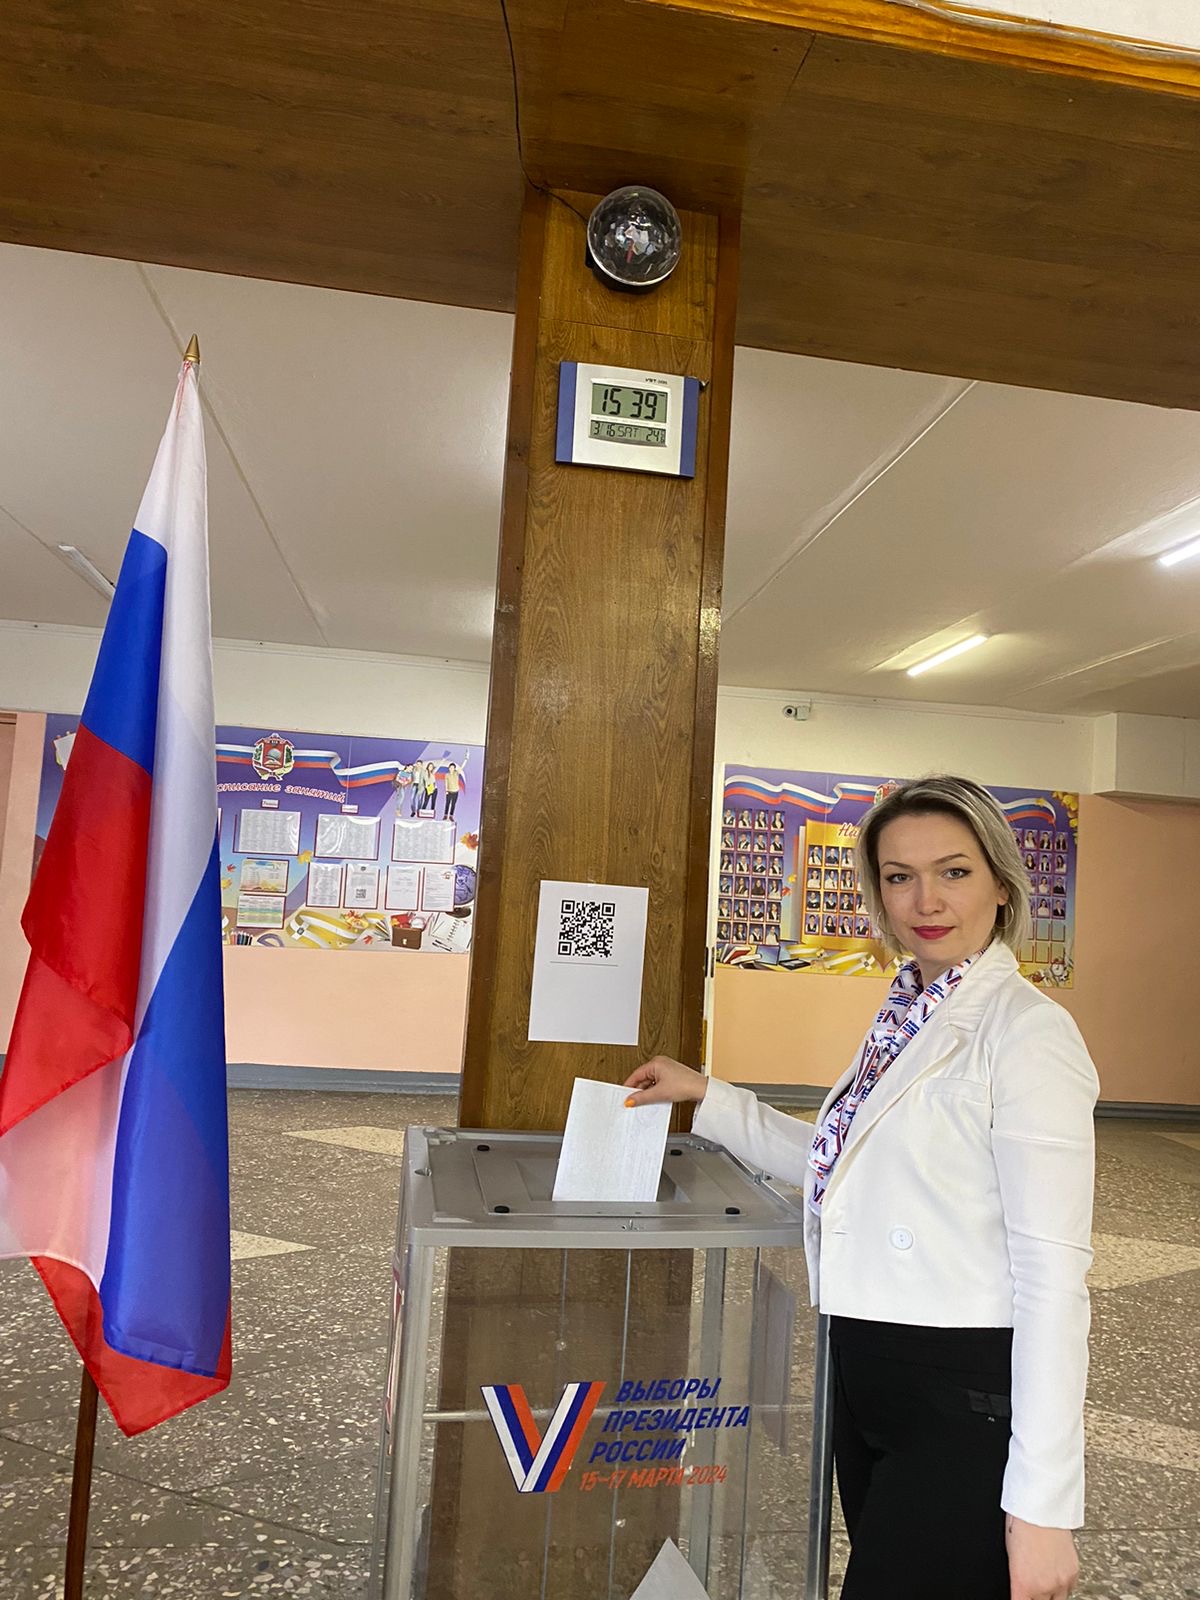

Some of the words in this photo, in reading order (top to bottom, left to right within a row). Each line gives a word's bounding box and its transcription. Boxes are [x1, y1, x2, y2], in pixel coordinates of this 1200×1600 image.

[602, 388, 622, 415] 15
[630, 391, 657, 420] 39
[618, 426, 639, 438] SAT
[285, 785, 346, 804] занятий
[615, 1377, 721, 1402] ВЫБОРЫ
[602, 1406, 750, 1432] ПРЕЗИДЕНТА
[588, 1438, 687, 1463] РОССИИ
[627, 1467, 685, 1489] МАРТА
[687, 1465, 728, 1486] 2024
